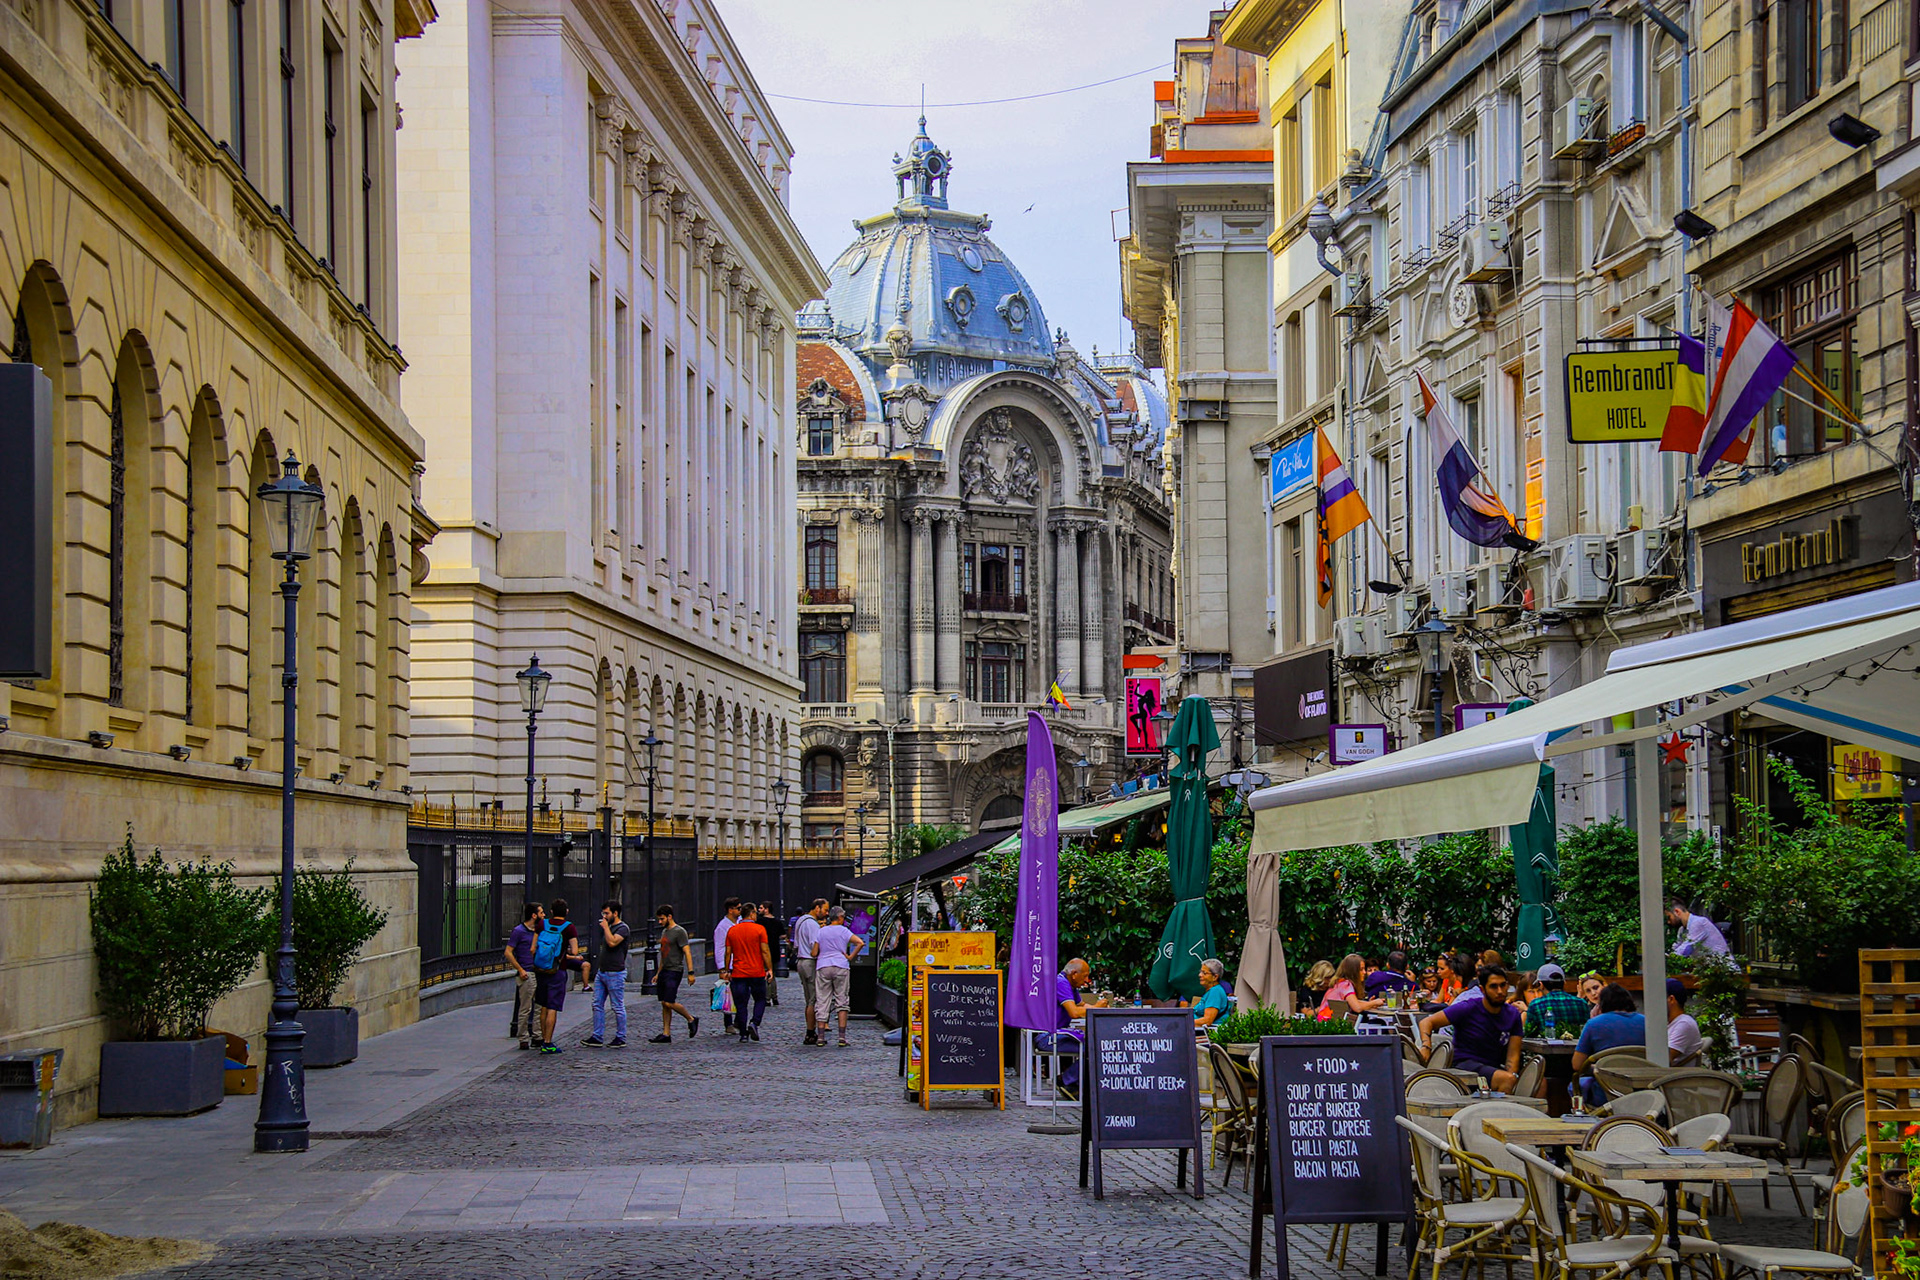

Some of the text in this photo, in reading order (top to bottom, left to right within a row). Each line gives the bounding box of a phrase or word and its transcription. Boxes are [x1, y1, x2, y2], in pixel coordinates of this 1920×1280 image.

[1607, 407, 1647, 430] HOTEL
[1862, 750, 1881, 782] Klein
[931, 981, 959, 995] COLD
[1127, 1022, 1153, 1034] BEER
[1100, 1039, 1121, 1051] DRAFT
[1124, 1039, 1149, 1052] NENEA
[1101, 1051, 1128, 1063] NENEA
[1102, 1063, 1142, 1075] PAULANER
[1316, 1058, 1347, 1074] FOOD
[1110, 1076, 1177, 1090] LOCAL CRAFT BEER
[1286, 1082, 1369, 1100] SOUP OF THE DAY
[1288, 1102, 1361, 1118] CLASSIC BURGER
[1289, 1119, 1372, 1137] BURGER CAPRESE
[1292, 1139, 1358, 1157] CHILLI PASTA
[1294, 1160, 1361, 1178] BACON PASTA
